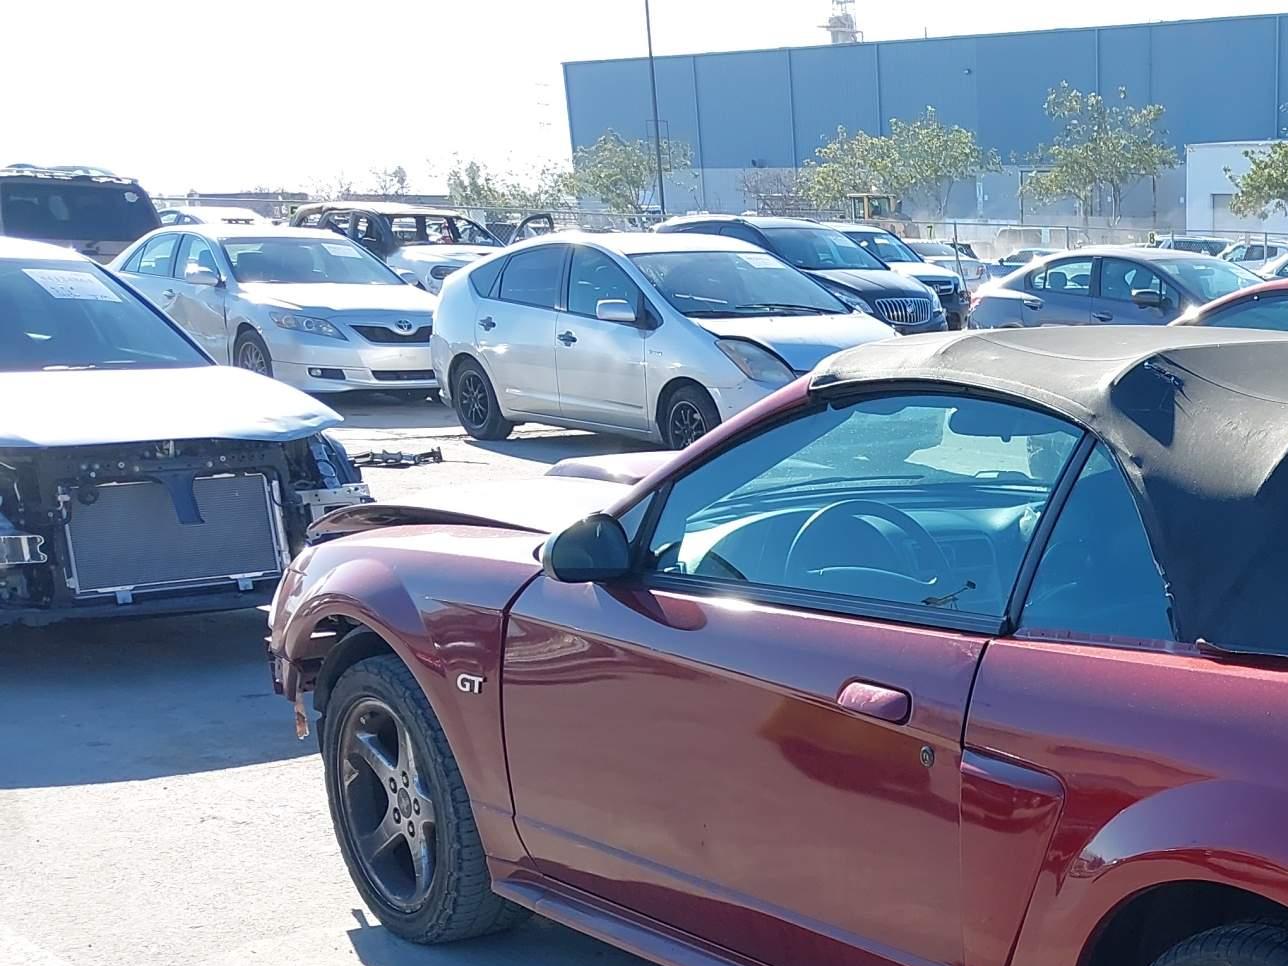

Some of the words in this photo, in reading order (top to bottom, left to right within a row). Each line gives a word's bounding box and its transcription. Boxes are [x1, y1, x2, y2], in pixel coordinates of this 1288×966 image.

[927, 225, 933, 239] 7
[1149, 232, 1155, 244] 8
[457, 673, 485, 694] GT
